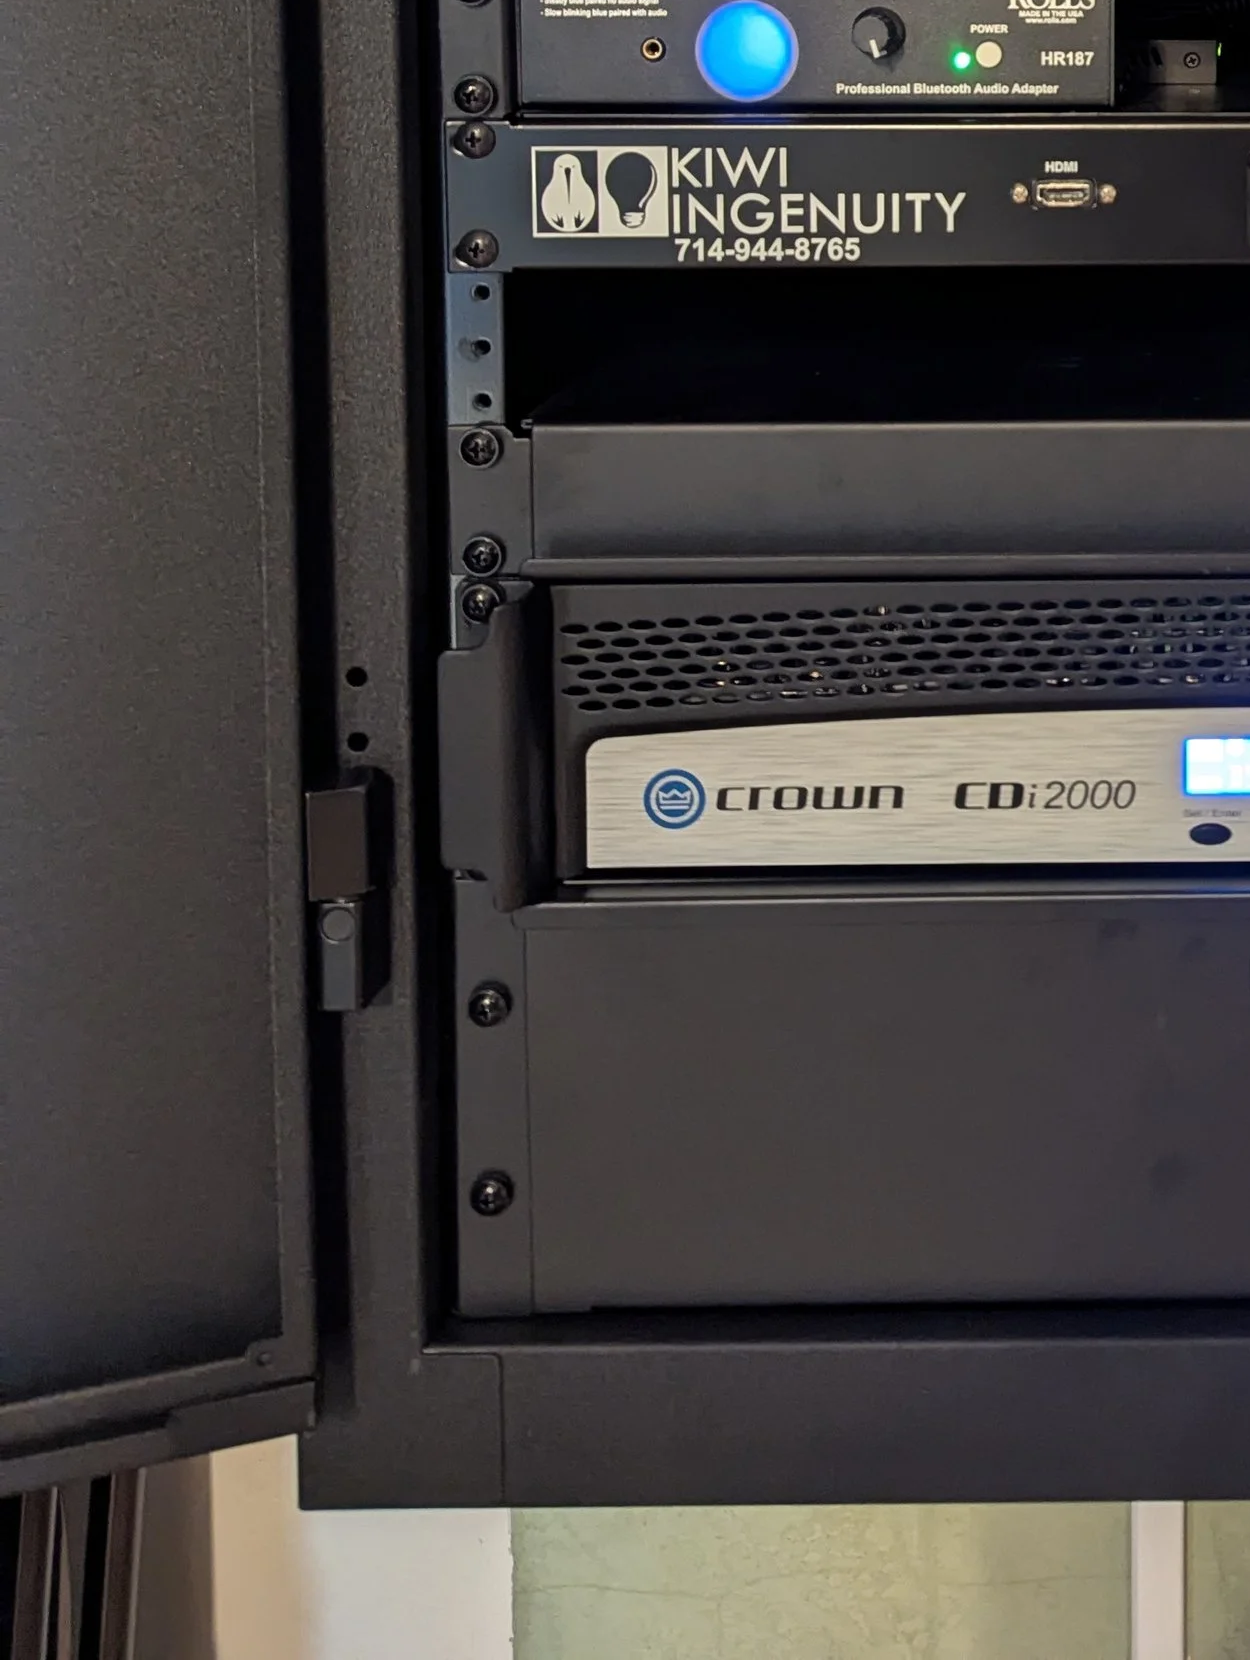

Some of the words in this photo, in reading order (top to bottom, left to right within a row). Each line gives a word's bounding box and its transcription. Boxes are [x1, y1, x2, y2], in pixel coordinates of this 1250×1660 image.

[544, 8, 562, 16] Slow
[563, 8, 591, 18] blinking
[592, 8, 607, 16] blue
[608, 8, 631, 18] paired
[632, 8, 647, 16] with
[648, 8, 668, 17] audio
[970, 24, 1008, 34] POWER
[1040, 51, 1094, 66] HR187
[836, 83, 911, 95] Professional
[913, 83, 971, 95] Bluetooth
[973, 83, 1010, 95] Audio
[1011, 83, 1059, 97] Adapter
[672, 147, 787, 188] KIWI
[1045, 161, 1078, 173] HDMI
[673, 192, 966, 235] INGENUITY
[675, 238, 861, 262] 714-944-8765
